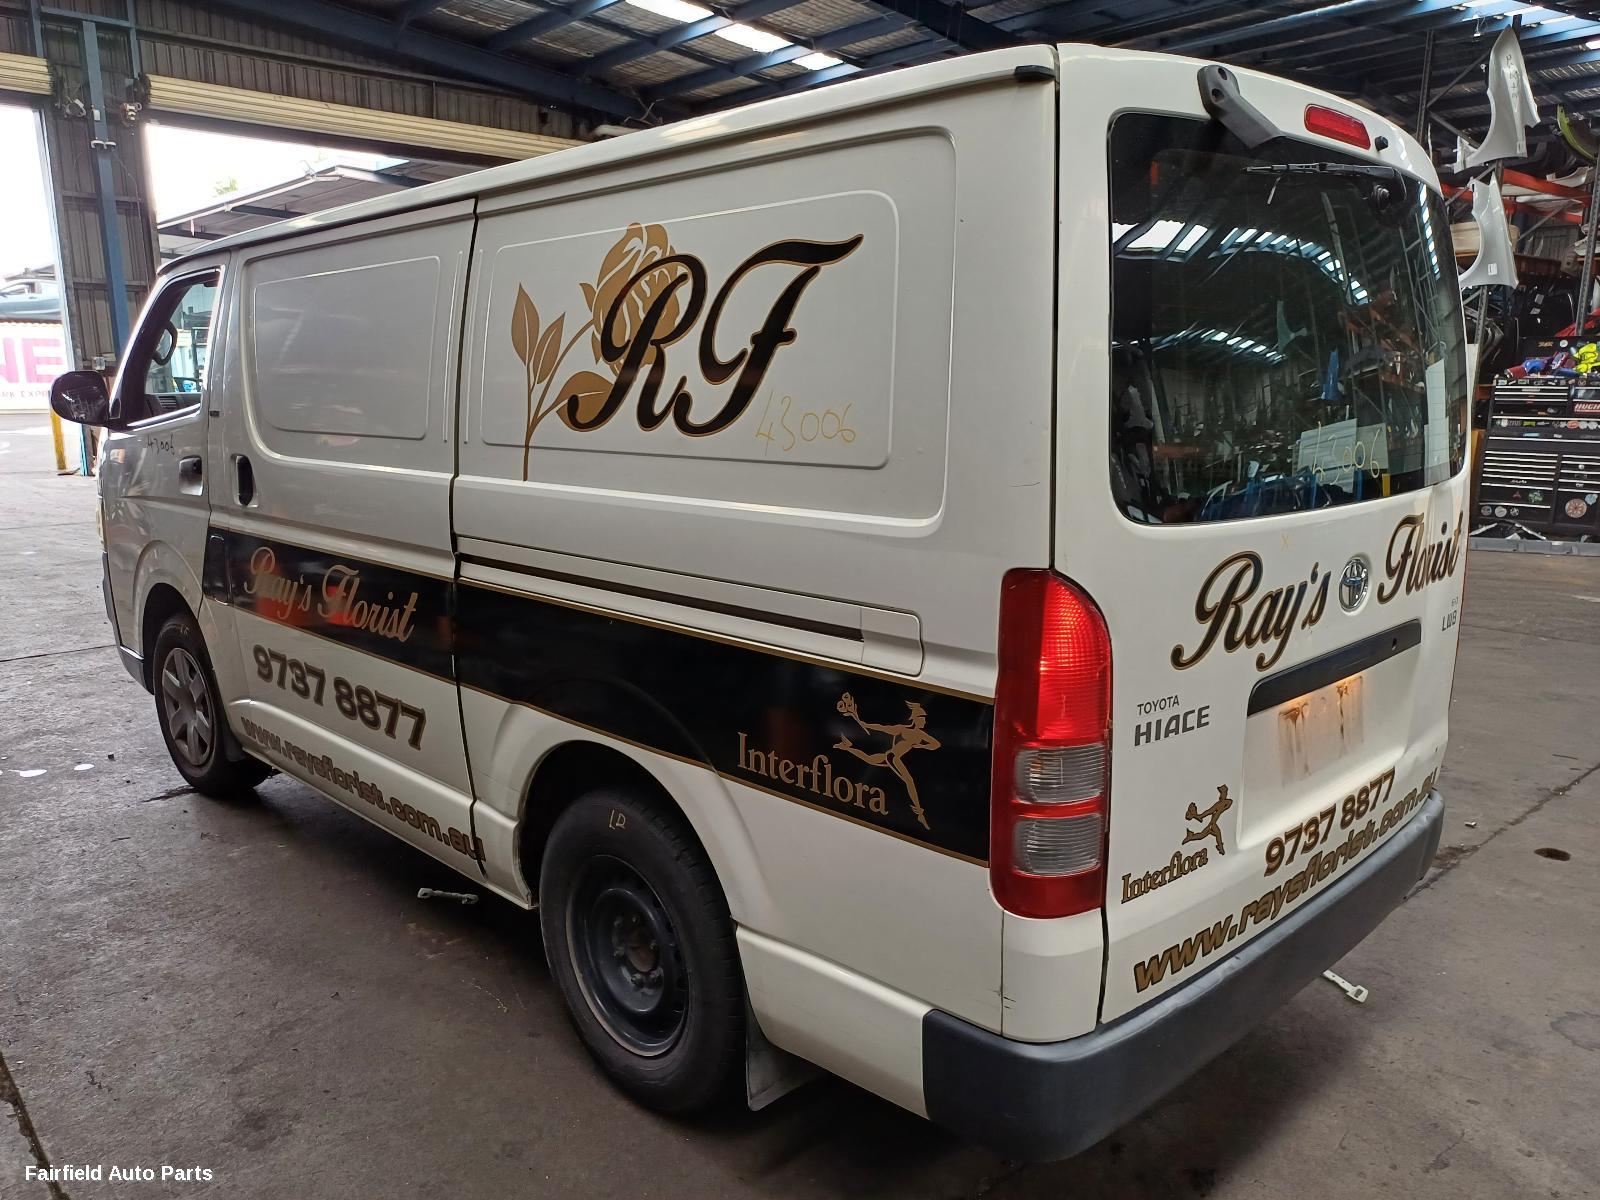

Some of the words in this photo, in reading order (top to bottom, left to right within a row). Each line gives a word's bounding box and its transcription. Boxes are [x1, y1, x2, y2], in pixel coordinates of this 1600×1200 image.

[754, 388, 857, 457] 43006
[243, 546, 313, 620] Ray's
[317, 564, 418, 642] Florist
[1170, 550, 1332, 672] Ray's
[1377, 510, 1464, 605] Florist
[253, 644, 327, 706] 9737
[333, 676, 427, 750] 8877
[1133, 704, 1211, 747] HIACE
[1136, 694, 1180, 717] TOYOTA
[241, 716, 487, 863] www.raysflorist.com.au
[737, 731, 889, 816] Interflora
[1263, 803, 1337, 877] 9737
[1340, 765, 1396, 831] 8877
[1121, 847, 1209, 904] Interflora
